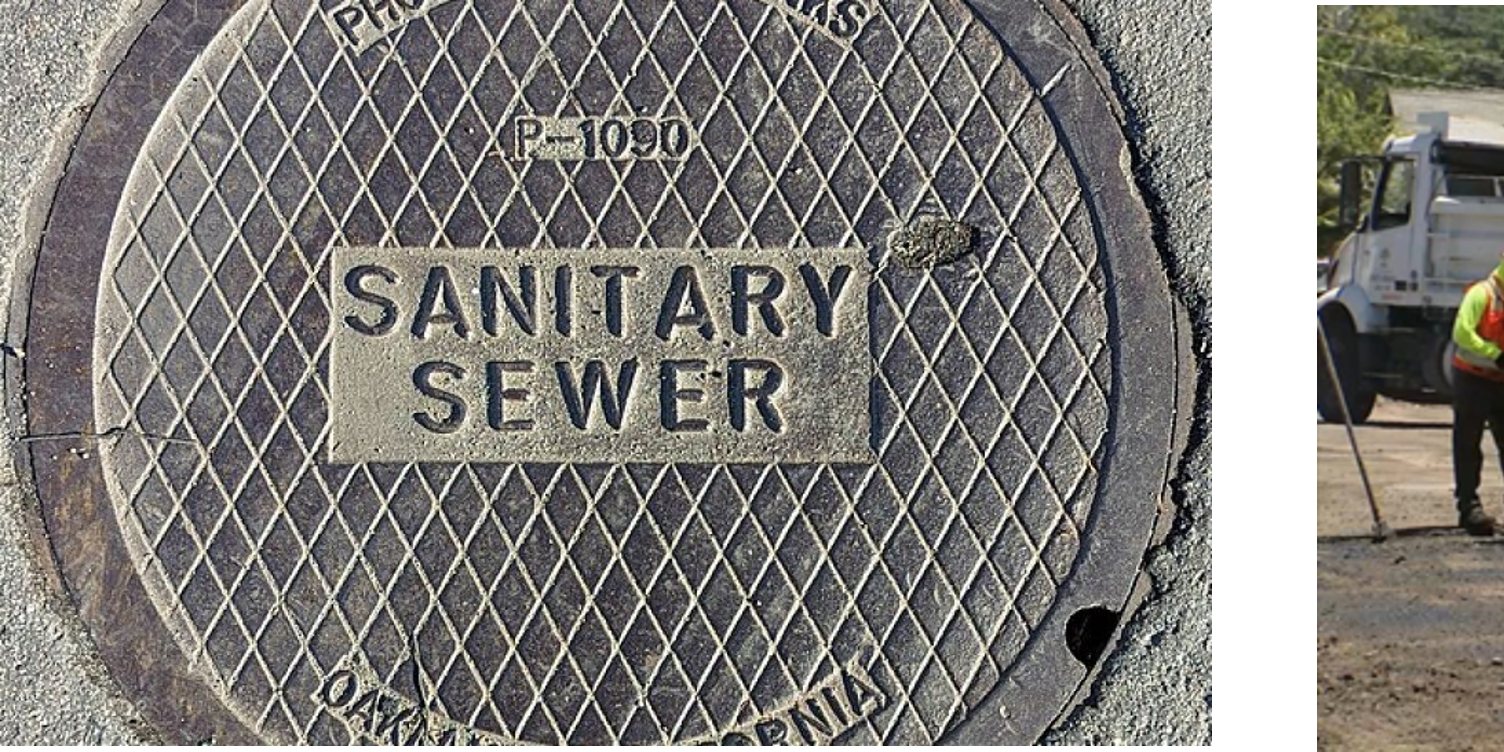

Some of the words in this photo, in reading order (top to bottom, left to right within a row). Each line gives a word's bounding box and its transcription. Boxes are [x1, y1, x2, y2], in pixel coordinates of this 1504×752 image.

[516, 119, 690, 157] P-1090
[344, 263, 856, 340] SANITARY
[411, 357, 788, 433] SEWER
